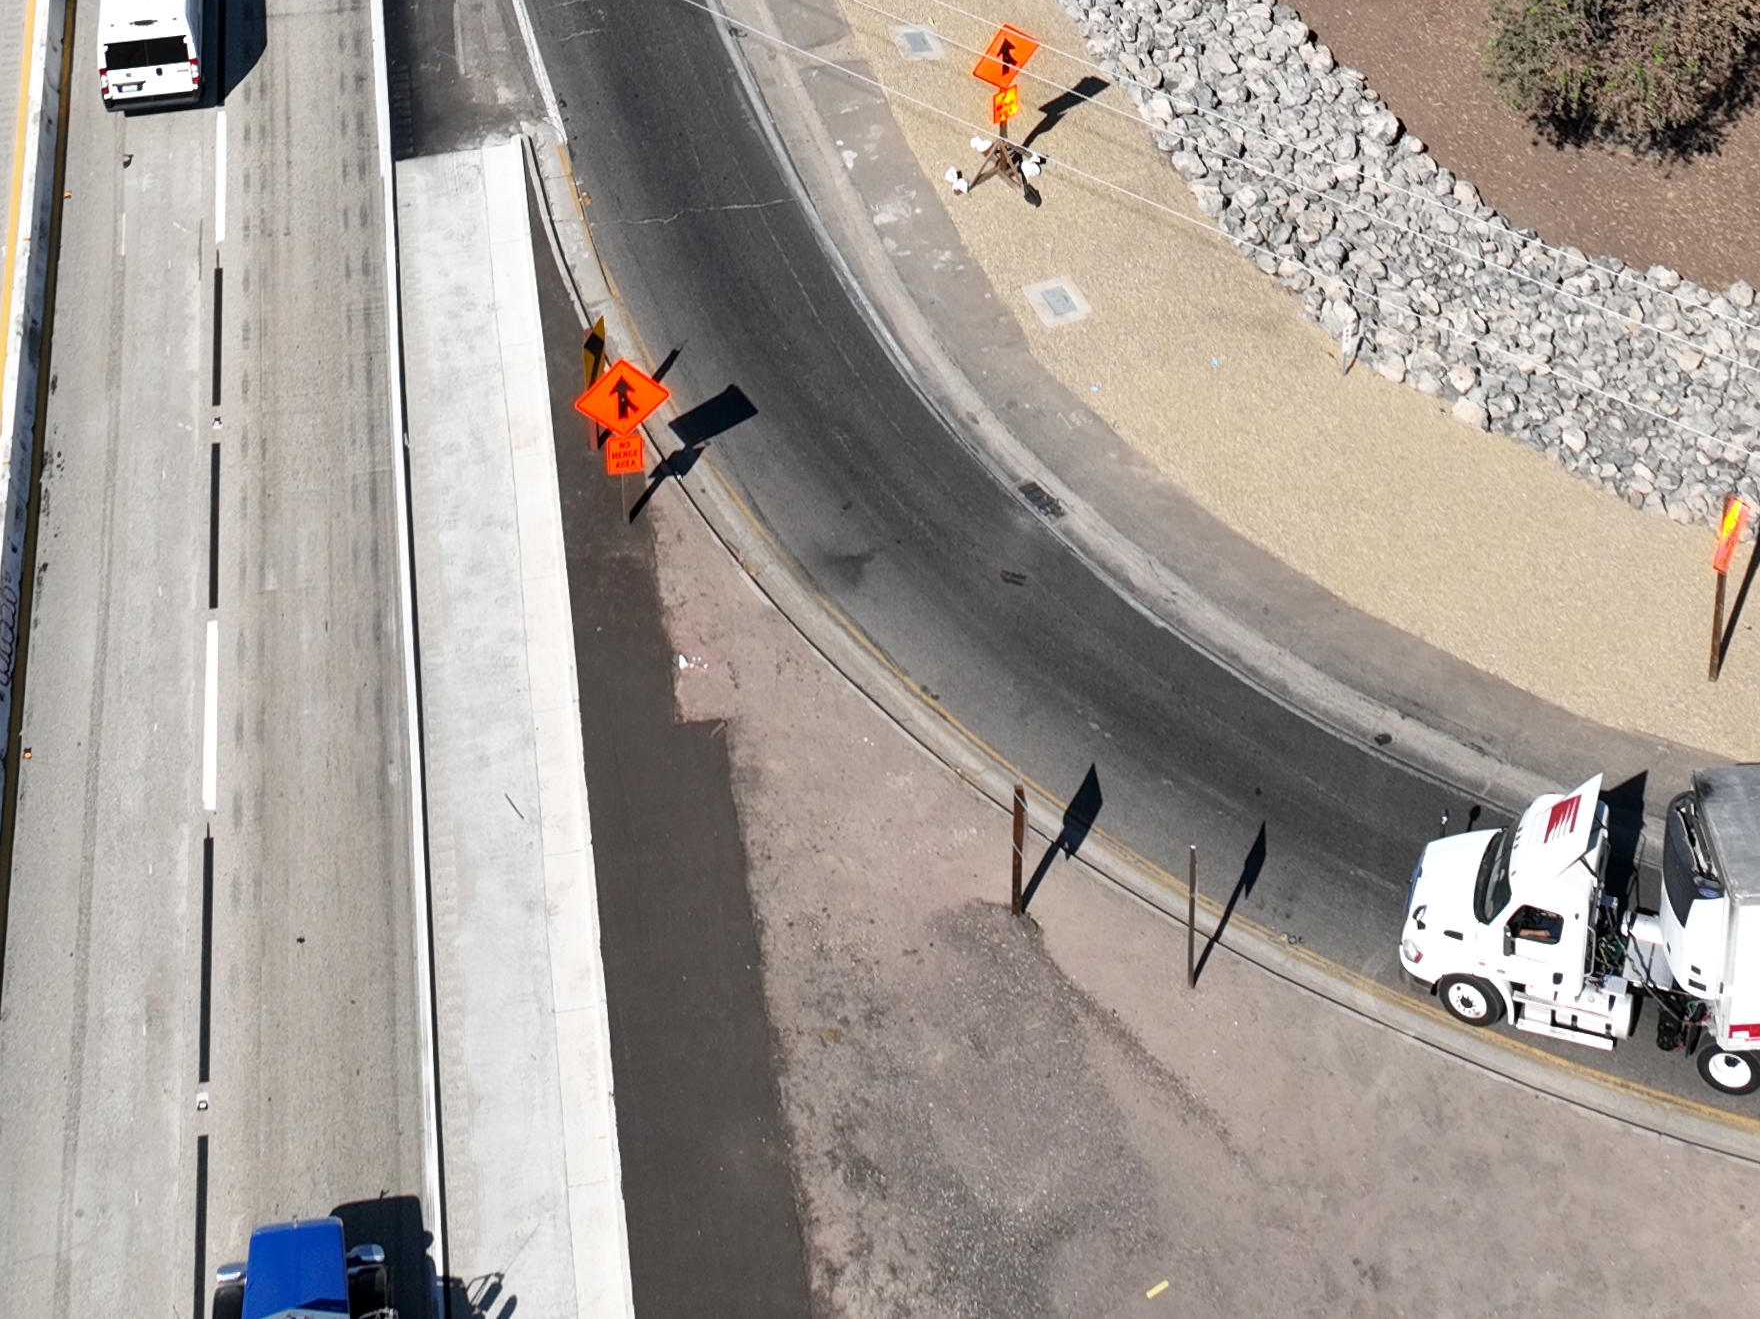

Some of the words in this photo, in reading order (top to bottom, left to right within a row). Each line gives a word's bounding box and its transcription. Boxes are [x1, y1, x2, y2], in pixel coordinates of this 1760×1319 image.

[619, 440, 631, 449] NO
[611, 449, 639, 460] MERGE
[615, 459, 637, 470] AREA
